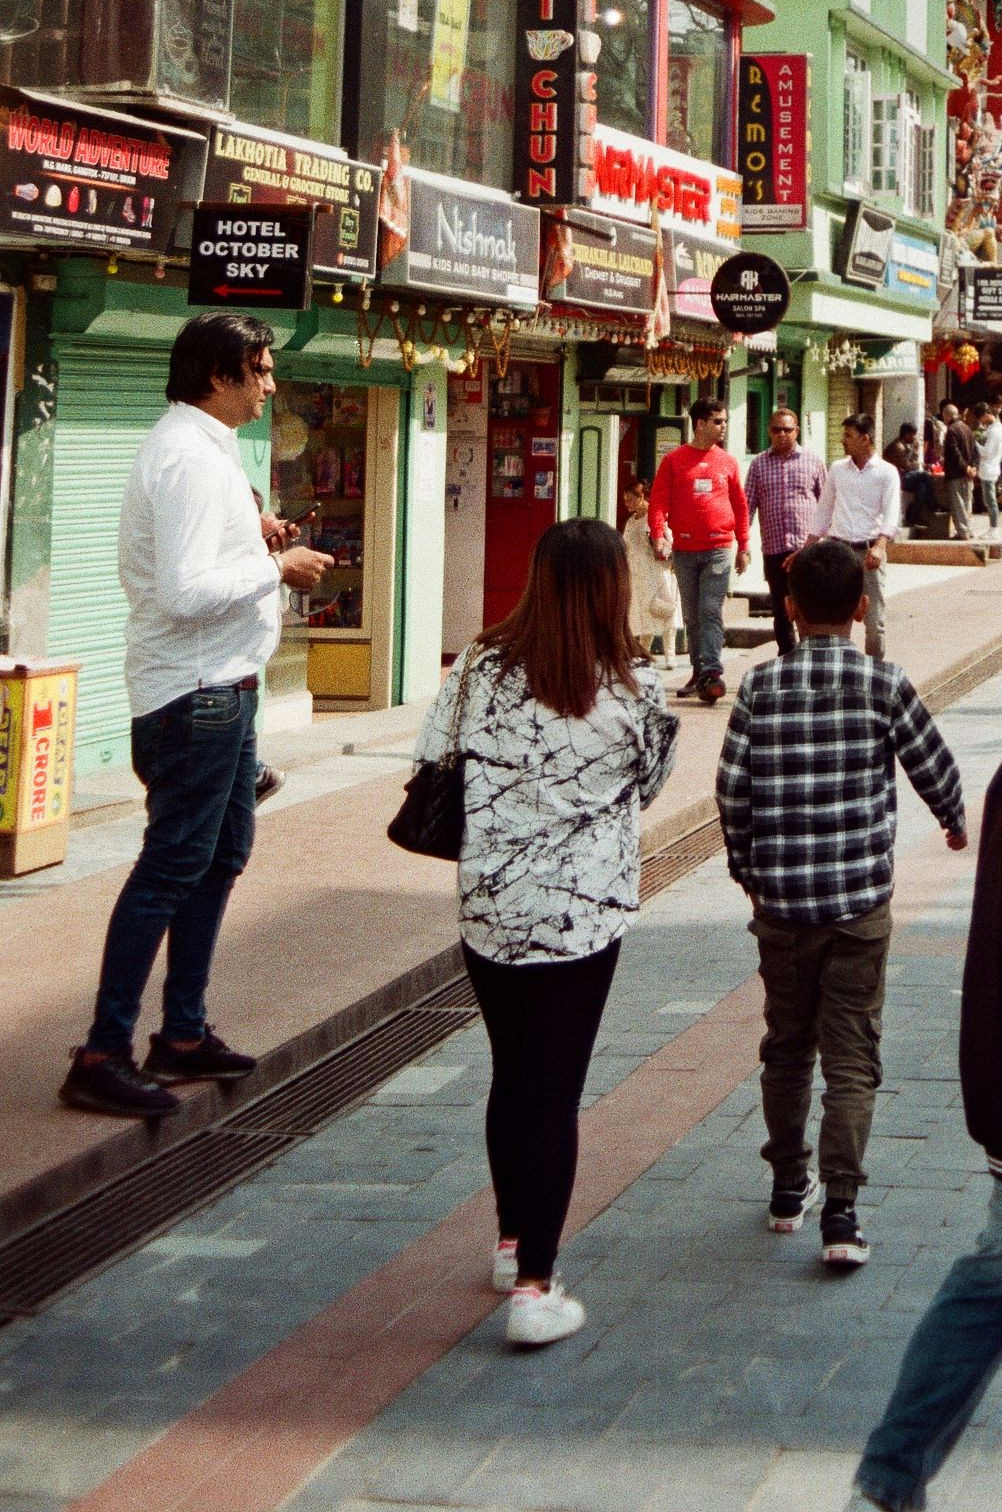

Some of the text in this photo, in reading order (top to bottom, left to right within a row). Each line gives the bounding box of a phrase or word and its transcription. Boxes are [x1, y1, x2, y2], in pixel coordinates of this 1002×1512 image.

[8, 112, 172, 179] WORLD ADVENTURE
[528, 70, 559, 197] CHUN
[778, 64, 793, 201] AMUSEMENT
[215, 133, 373, 193] LAKHOTIA TRADING CO.
[243, 166, 281, 188] GENERAL
[290, 178, 325, 198] GROCERY
[325, 184, 350, 203] STORE
[217, 220, 286, 237] HOTEL
[199, 241, 299, 259] OCTOBER
[432, 257, 452, 272] KIDS
[453, 262, 470, 276] AND
[471, 264, 491, 279] BABY
[226, 262, 270, 279] SKY
[716, 293, 782, 301] HAIRMASTER
[31, 700, 53, 822] 1 CRORE
